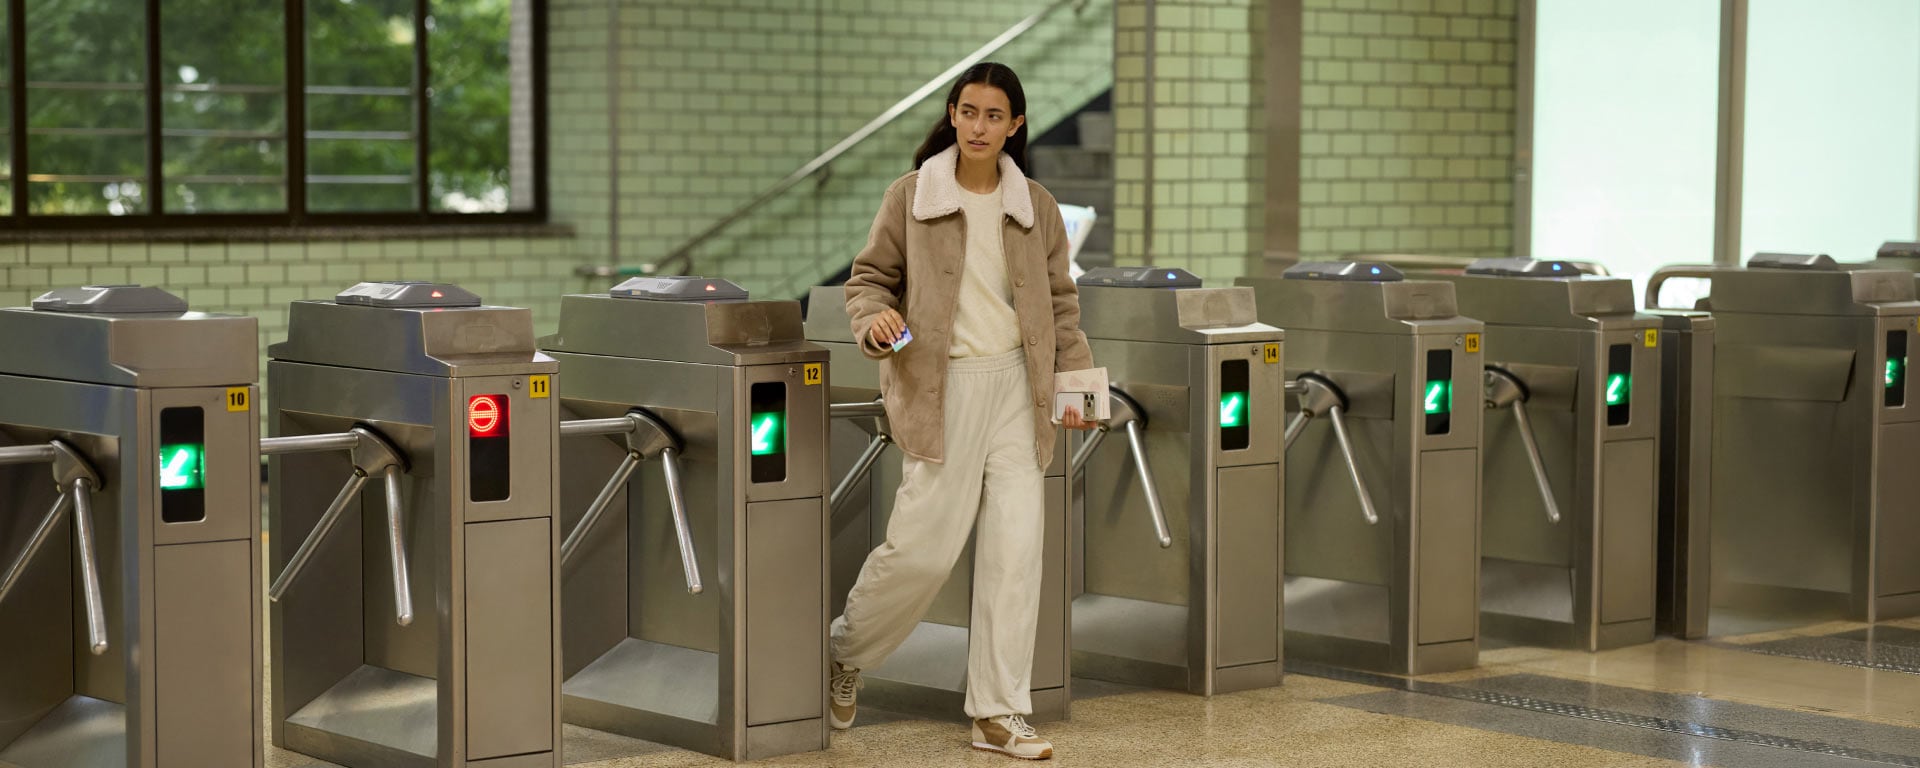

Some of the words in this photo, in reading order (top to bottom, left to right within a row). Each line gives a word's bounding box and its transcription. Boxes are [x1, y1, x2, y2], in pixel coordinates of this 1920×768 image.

[1468, 337, 1477, 348] 15
[1266, 348, 1276, 359] 14
[806, 368, 818, 380] 12
[533, 380, 545, 393] 11
[230, 392, 244, 406] 10
